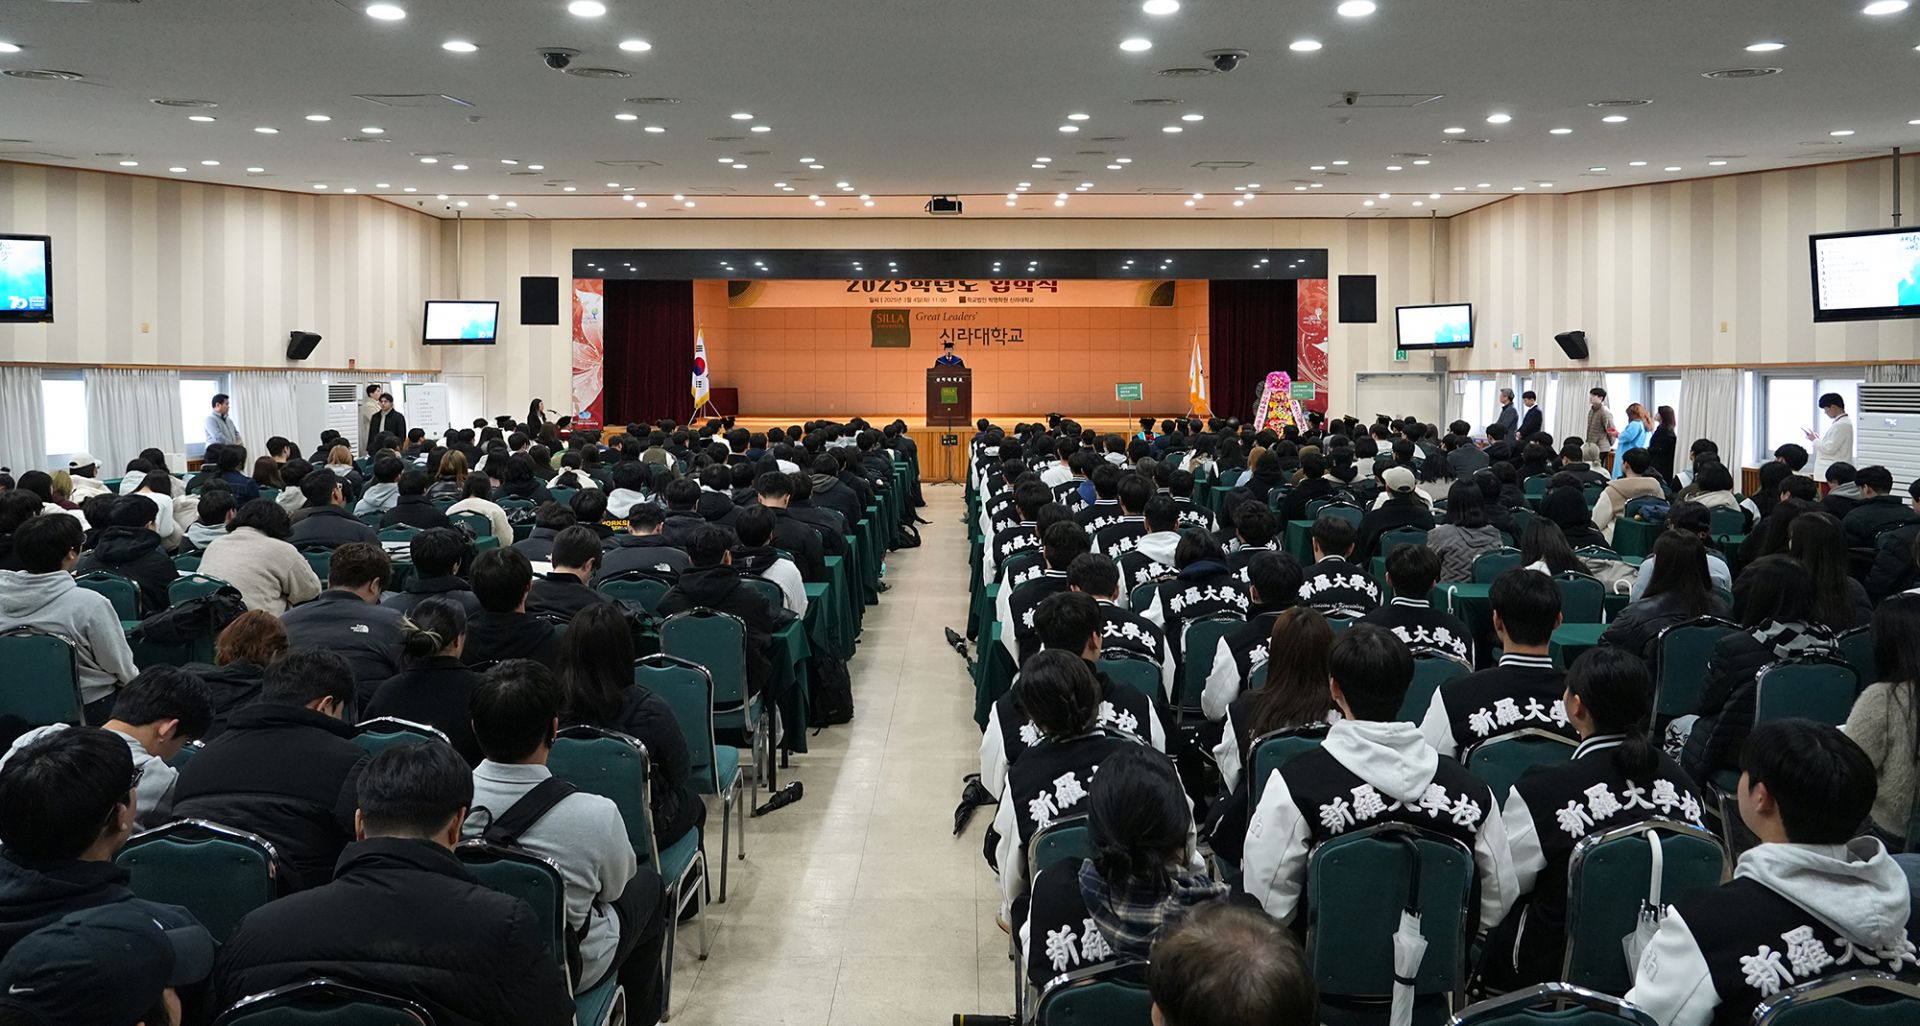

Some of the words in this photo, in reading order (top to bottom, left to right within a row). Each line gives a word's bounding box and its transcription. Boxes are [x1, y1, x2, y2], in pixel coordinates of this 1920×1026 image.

[990, 279, 1058, 293] 입학식
[877, 313, 905, 324] SILLA
[916, 312, 940, 321] Great
[939, 327, 1024, 346] 신라대학교
[1555, 779, 1704, 839] 新羅大學校
